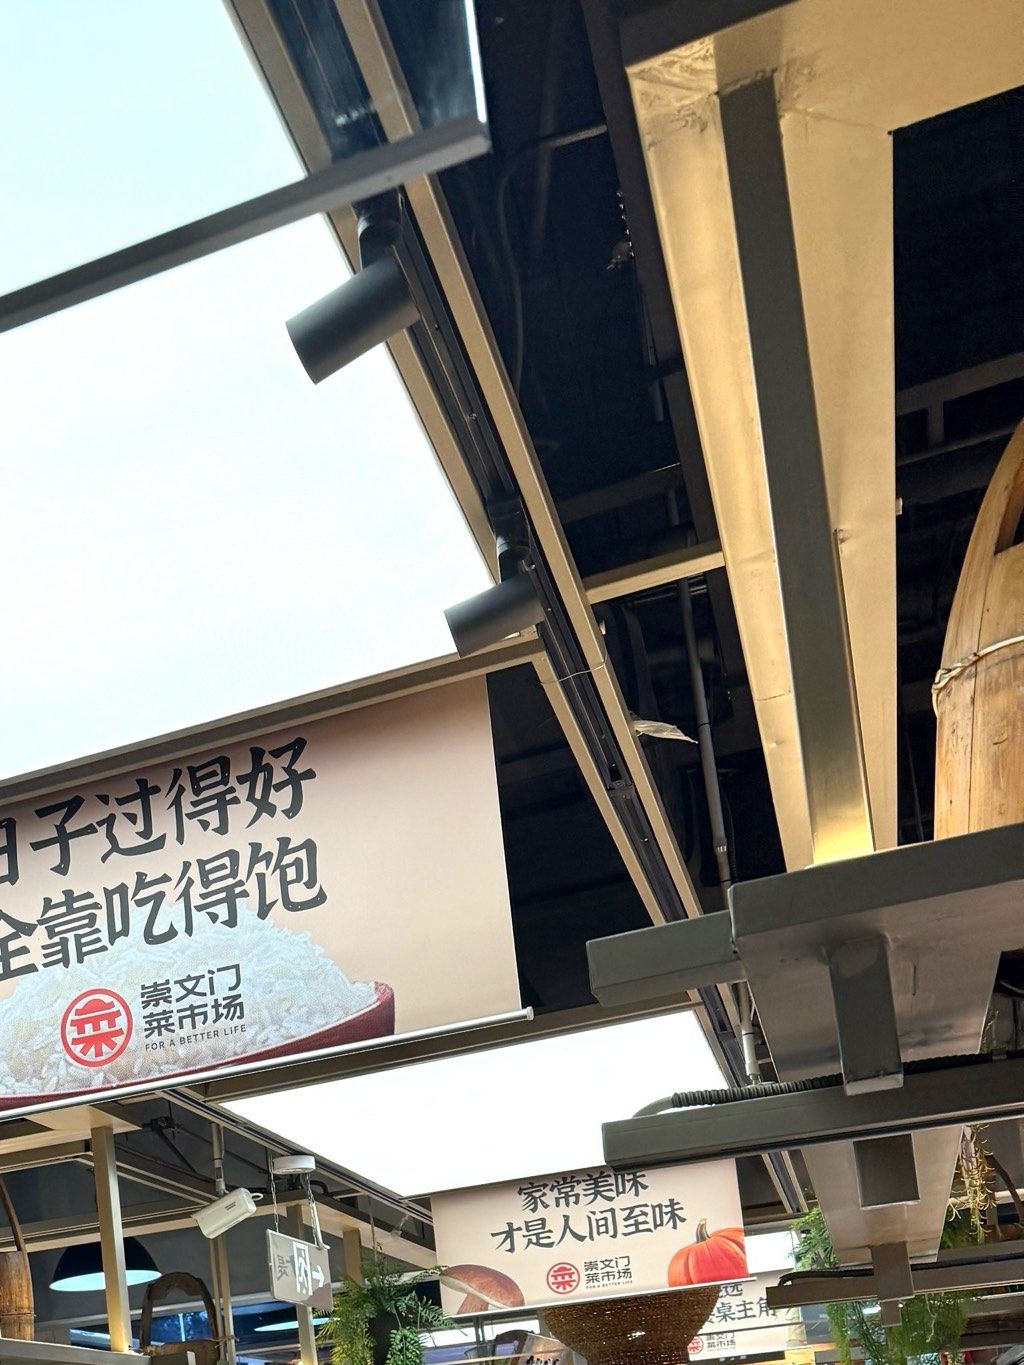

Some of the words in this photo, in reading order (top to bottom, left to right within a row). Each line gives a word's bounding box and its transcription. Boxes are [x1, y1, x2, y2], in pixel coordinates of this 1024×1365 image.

[140, 963, 242, 1010] 崇文门
[142, 993, 245, 1039] 菜市场
[145, 1041, 165, 1051] FOR
[180, 1030, 219, 1045] BETTER
[223, 1024, 247, 1036] LIFE
[517, 1170, 649, 1213] 家常美味
[491, 1198, 687, 1253] 才是人间至味
[584, 1255, 631, 1271] 崇文门
[585, 1267, 633, 1284] 菜市场
[708, 1297, 775, 1324] 桌主角
